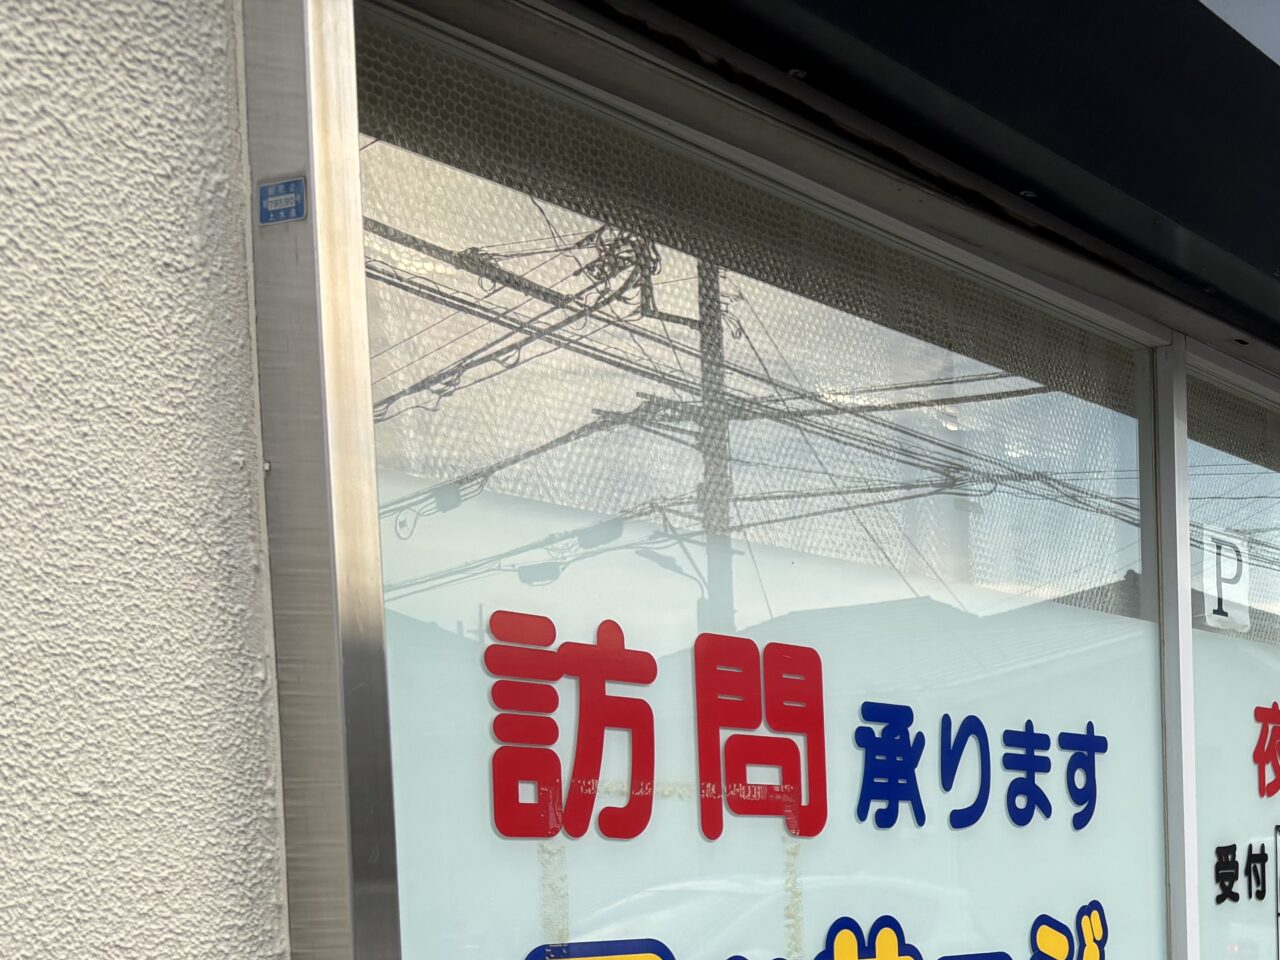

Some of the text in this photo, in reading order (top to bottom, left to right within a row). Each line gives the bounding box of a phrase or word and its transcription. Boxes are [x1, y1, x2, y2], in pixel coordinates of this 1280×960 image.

[1211, 537, 1243, 617] P
[485, 609, 1108, 840] 訪問 承ります
[1214, 843, 1269, 904] 受付
